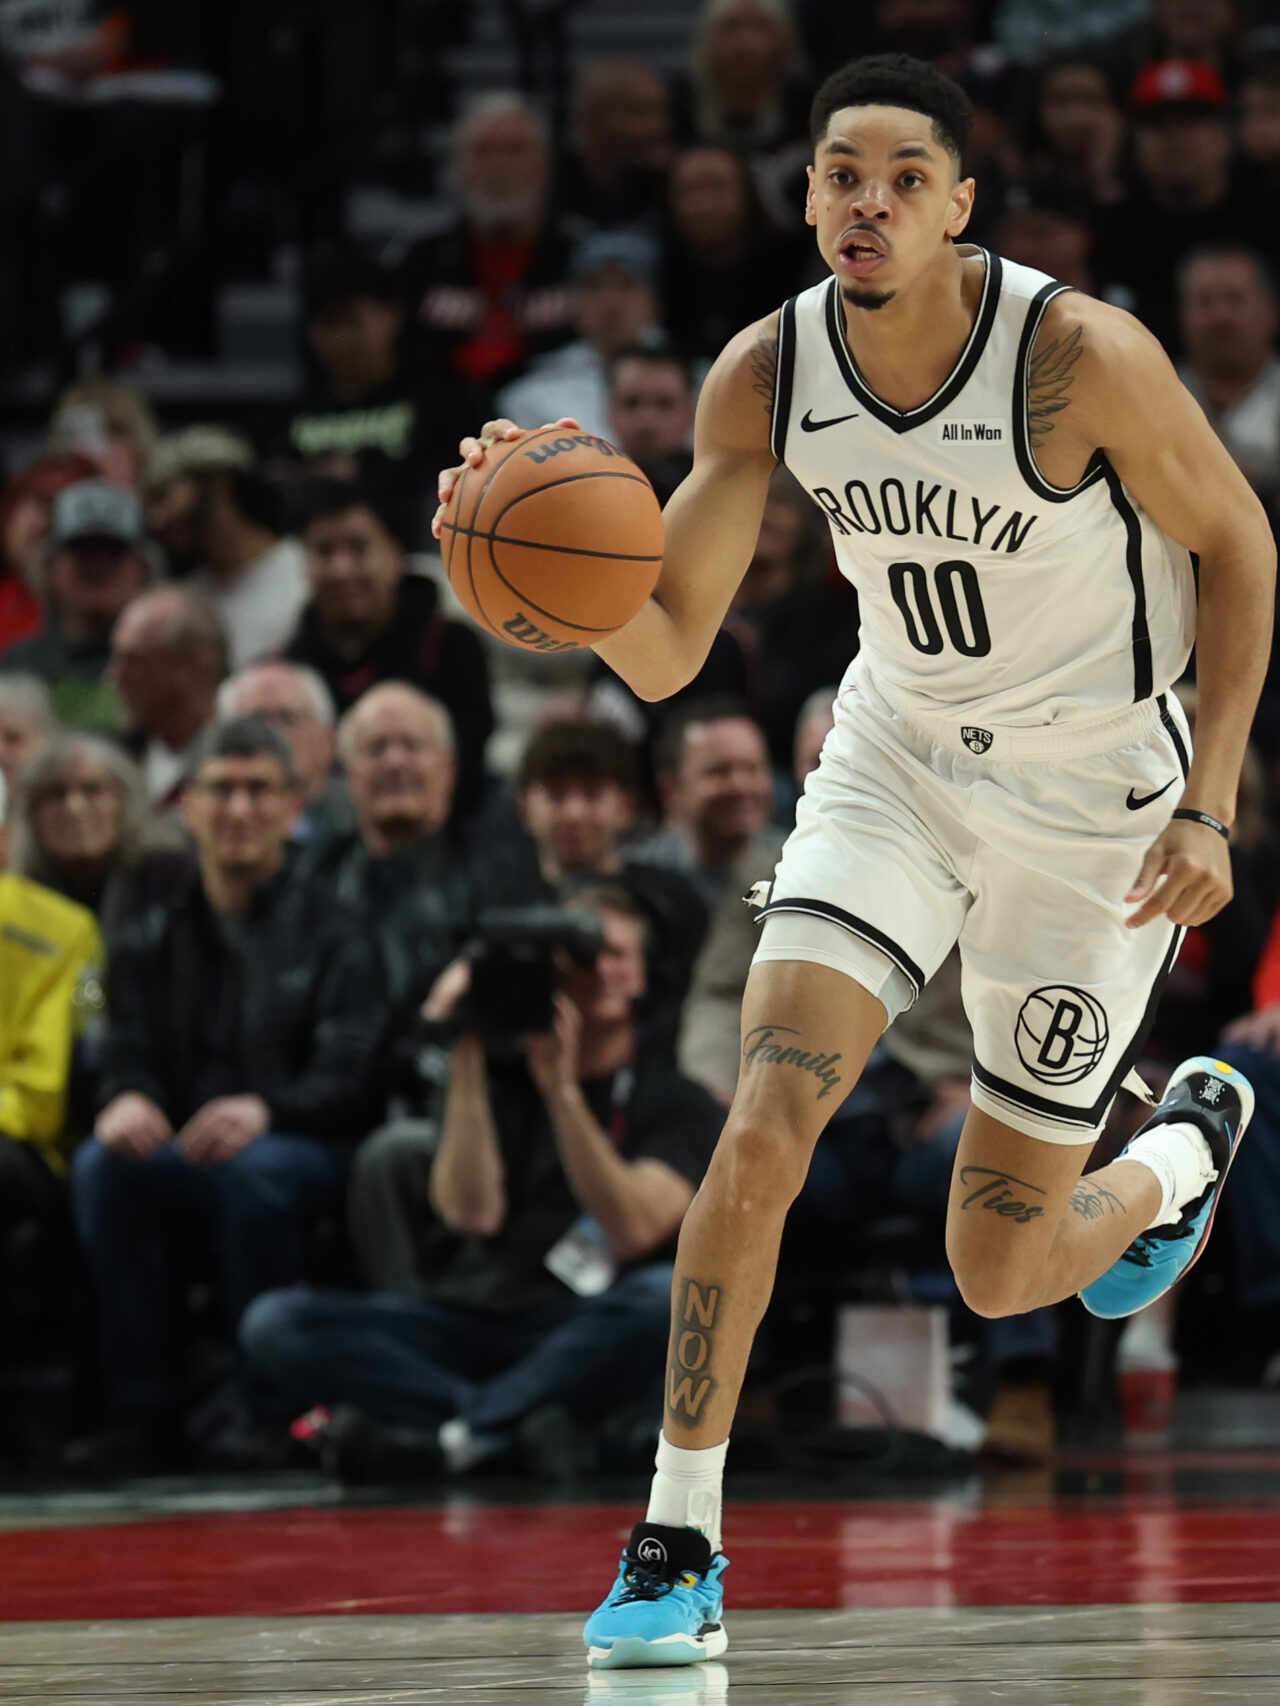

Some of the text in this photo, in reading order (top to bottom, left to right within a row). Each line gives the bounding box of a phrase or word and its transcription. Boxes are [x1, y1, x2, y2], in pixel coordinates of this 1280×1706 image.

[942, 423, 1002, 440] All In Won
[812, 478, 1038, 553] ROOKLYN
[888, 560, 991, 657] 00
[962, 728, 991, 744] NETS
[743, 1025, 843, 1100] Family
[1037, 998, 1083, 1069] B
[960, 1166, 1047, 1223] Ties
